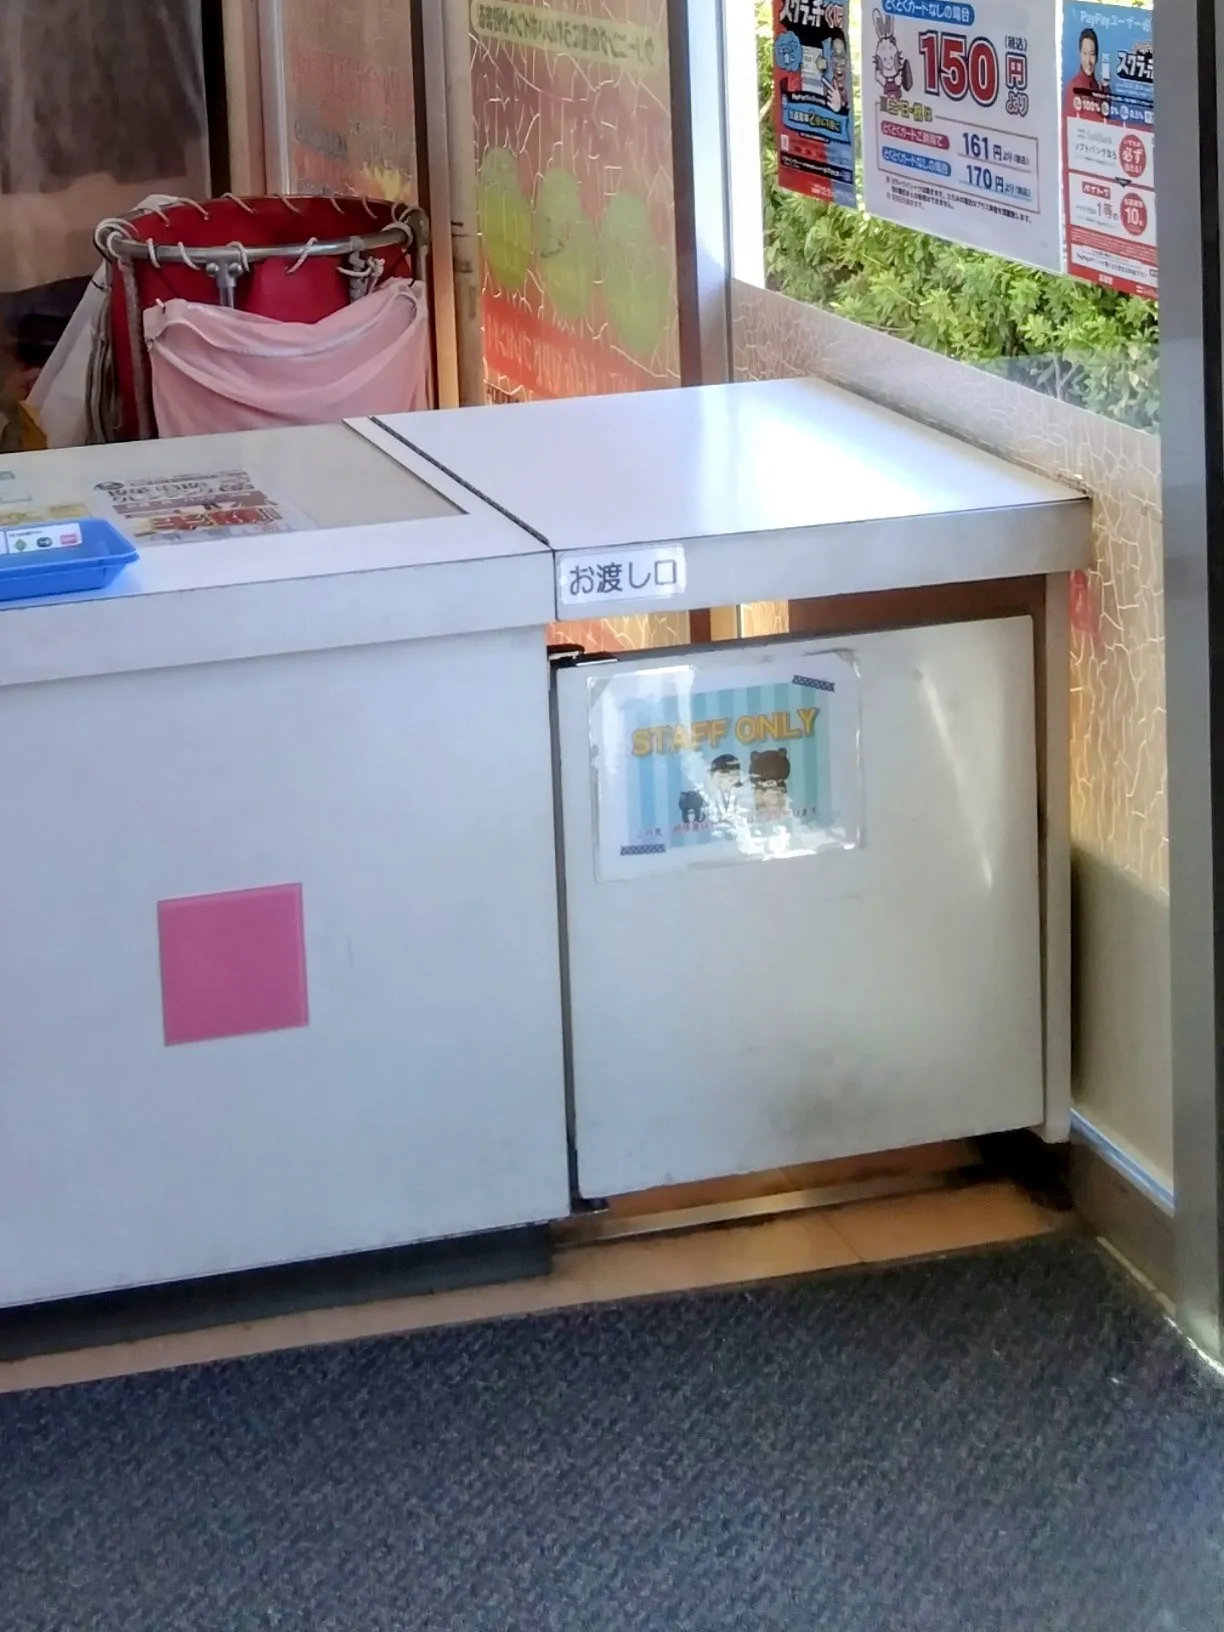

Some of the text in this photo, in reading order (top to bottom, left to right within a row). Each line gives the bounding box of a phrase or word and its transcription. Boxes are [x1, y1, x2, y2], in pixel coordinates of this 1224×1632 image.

[918, 29, 1000, 108] 150
[1004, 52, 1028, 91] 円
[1005, 91, 1030, 117] より
[569, 558, 677, 596] お渡し口
[630, 705, 820, 759] STAFF ONLY
